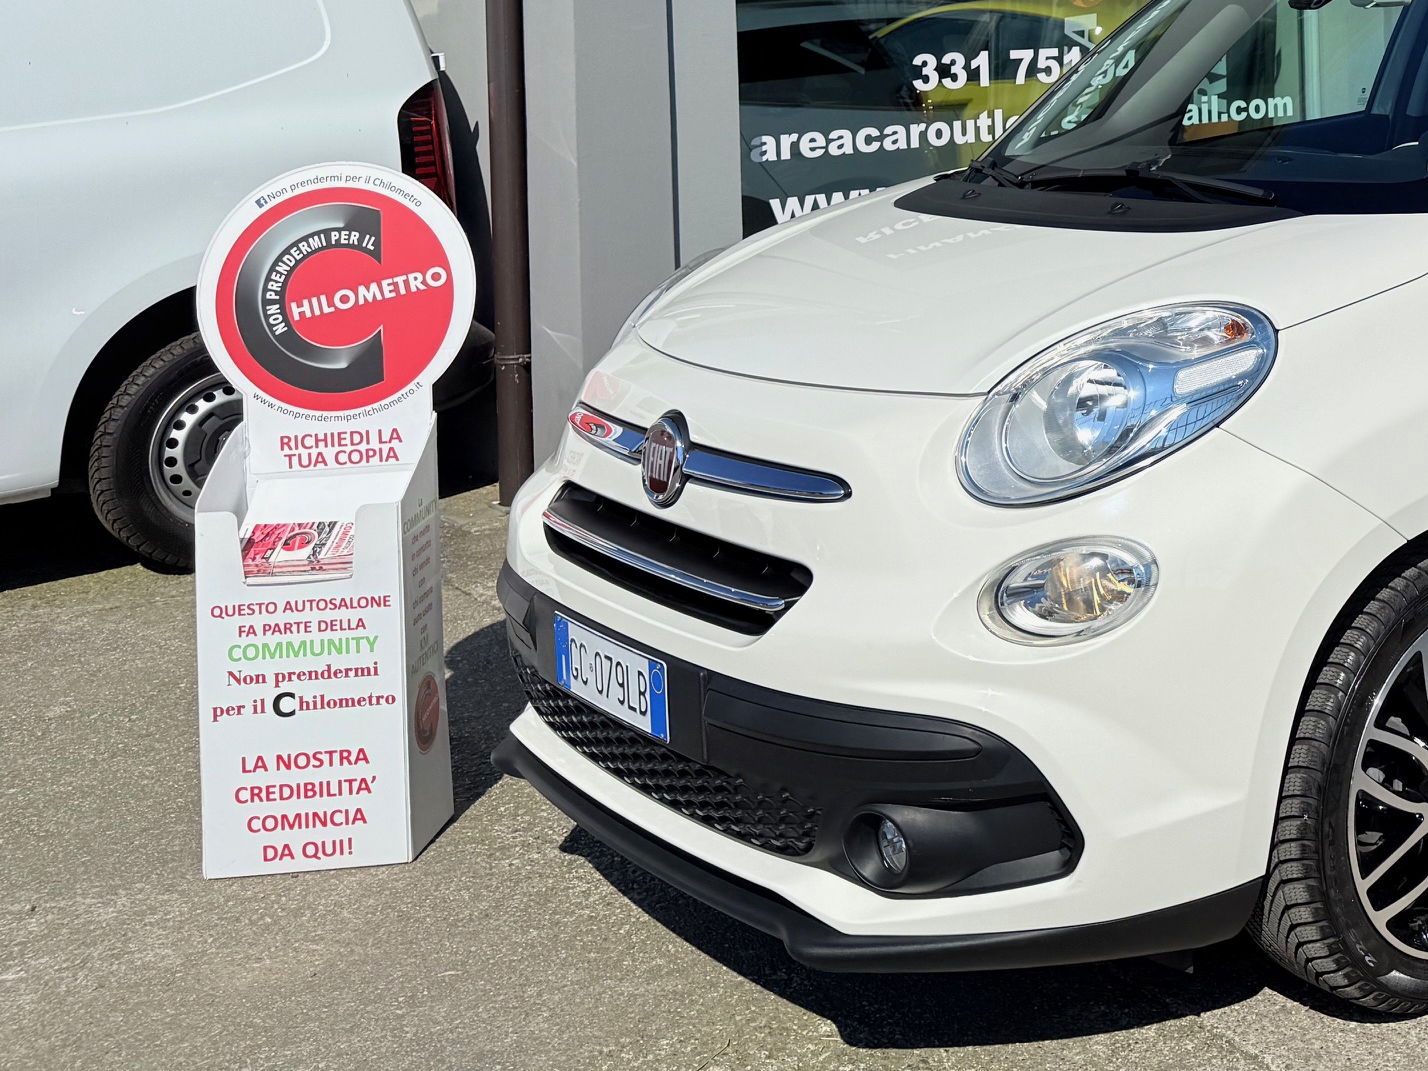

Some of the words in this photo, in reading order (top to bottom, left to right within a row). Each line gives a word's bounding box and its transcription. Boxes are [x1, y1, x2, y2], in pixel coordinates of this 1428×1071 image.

[912, 49, 990, 91] 331
[267, 188, 288, 202] Non
[290, 173, 343, 192] prendermi
[345, 174, 363, 185] per
[364, 174, 371, 185] il
[372, 177, 422, 208] Chilometro
[331, 230, 360, 245] PER
[362, 234, 376, 250] IL
[266, 233, 327, 300] PRENDERMI
[266, 304, 288, 336] NON
[252, 381, 423, 423] www.nonprendermiperilchilometro.it
[279, 430, 371, 452] RICHIEDI
[378, 428, 403, 445] LA
[284, 452, 328, 469] TUA
[334, 446, 400, 465] COPIA
[650, 442, 674, 482] FIAT
[210, 600, 278, 619] QUESTO
[282, 595, 392, 614] AUTOSALONE
[238, 624, 257, 638] FA
[263, 620, 312, 636] PARTE
[317, 617, 367, 633] DELLA
[227, 635, 379, 663] COMMUNITY
[226, 669, 268, 687] Non
[273, 661, 380, 688] prendermi
[212, 703, 246, 723] per
[252, 698, 267, 715] il
[272, 691, 396, 717] Chilometro
[241, 755, 268, 774] LA
[276, 748, 370, 771] NOSTRA
[246, 808, 368, 834] COMINCIA
[262, 843, 295, 863] DA
[301, 837, 354, 860] QUI!
